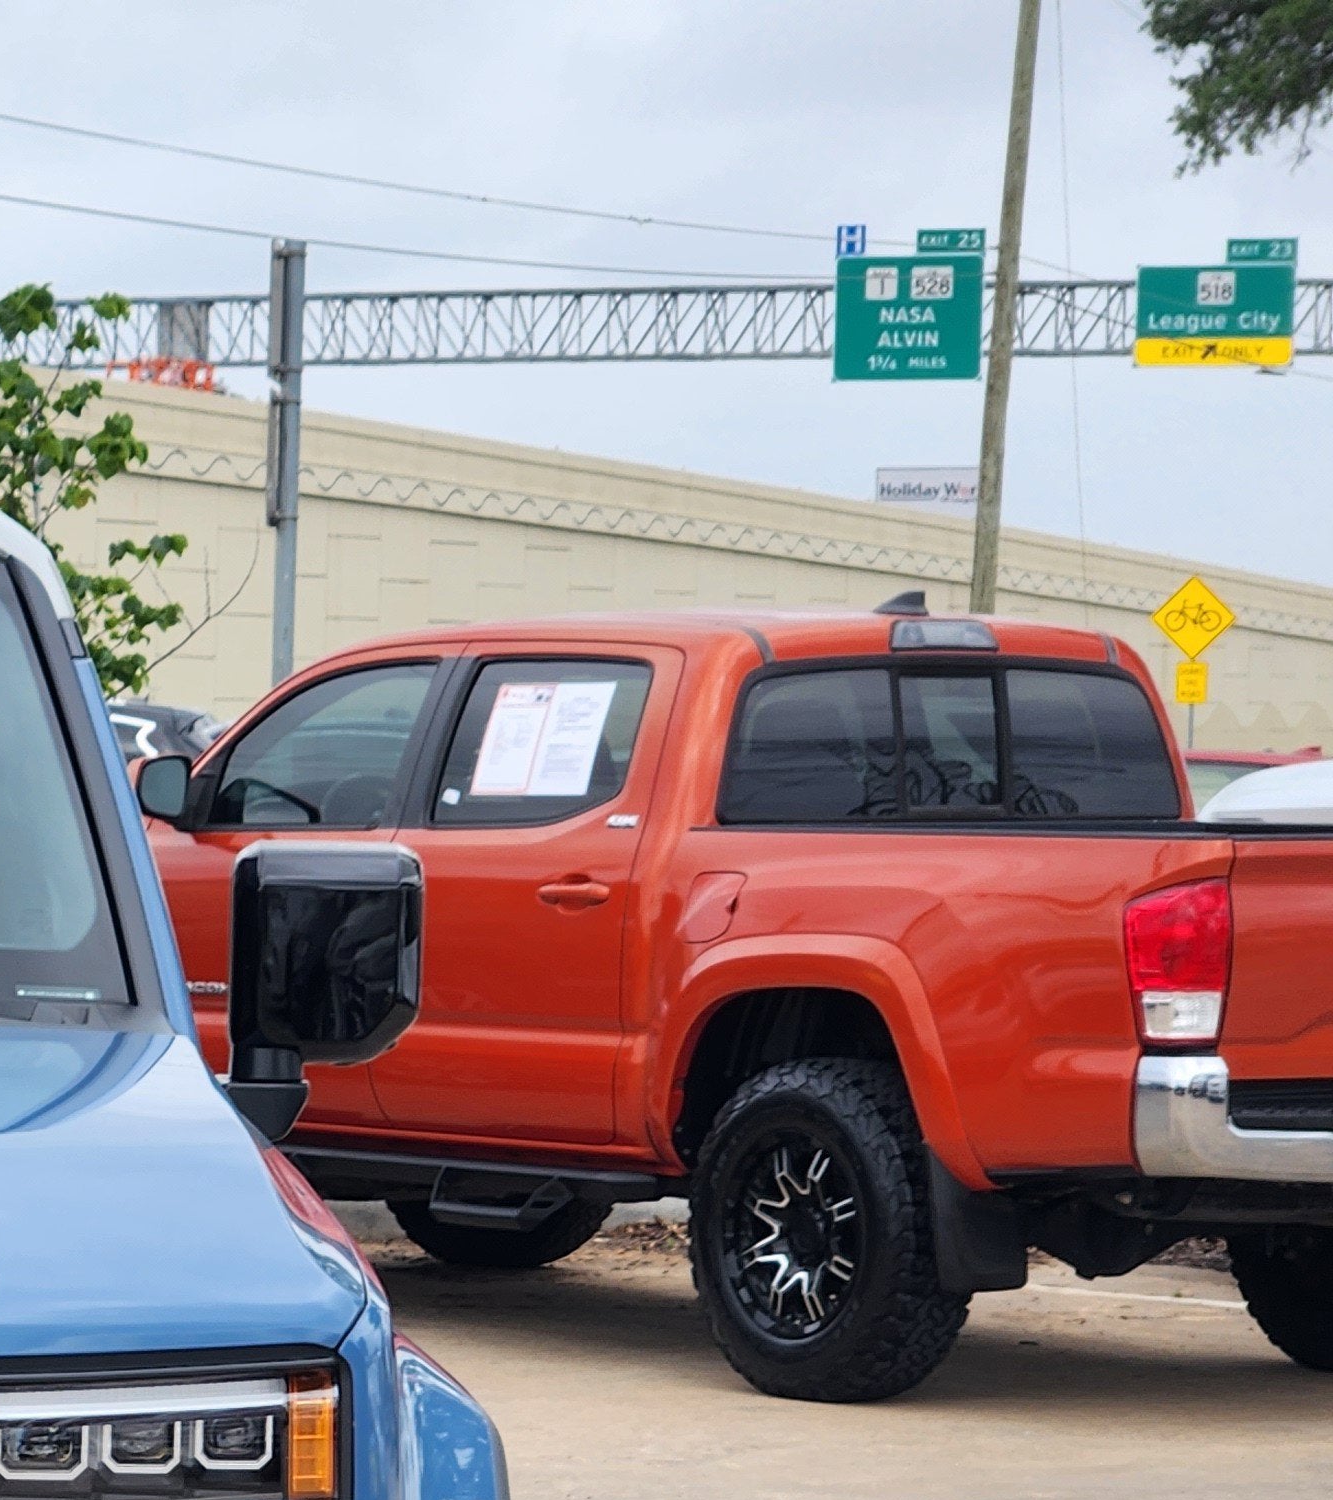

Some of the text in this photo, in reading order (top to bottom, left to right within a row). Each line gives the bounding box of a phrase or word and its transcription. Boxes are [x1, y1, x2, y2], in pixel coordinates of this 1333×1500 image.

[920, 232, 981, 248] EXIT 25
[1200, 282, 1233, 301] 518
[879, 306, 936, 324] NASA
[1148, 309, 1281, 334] League City
[877, 330, 939, 348] ALVIN
[1161, 345, 1265, 358] EXIT ONLY
[908, 356, 948, 369] MILES
[879, 481, 941, 499] Holiday
